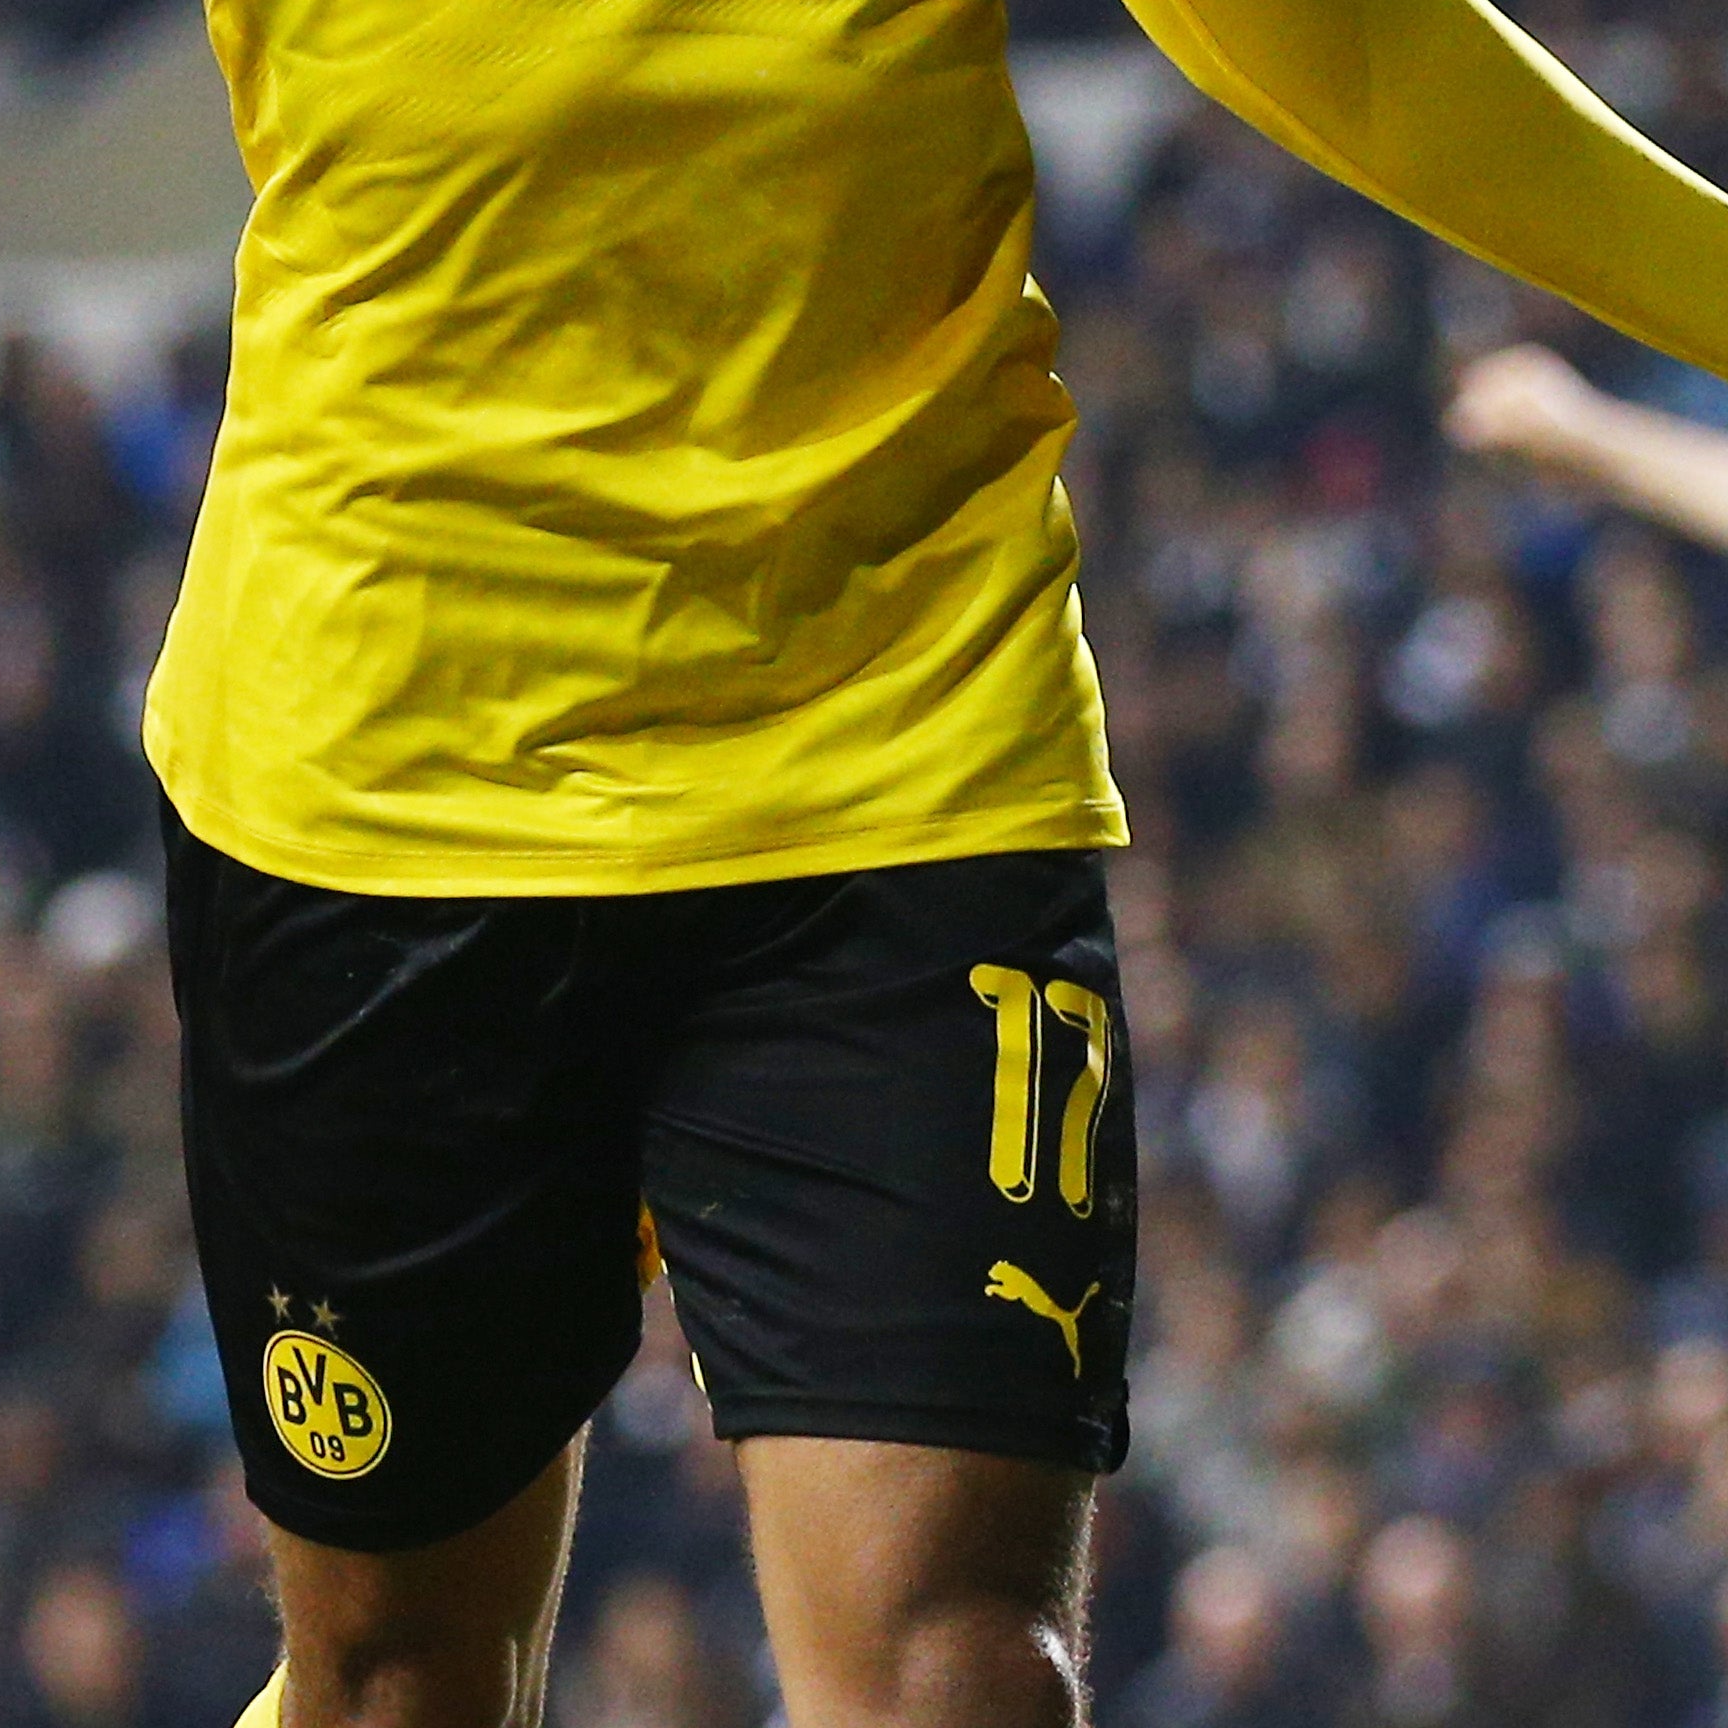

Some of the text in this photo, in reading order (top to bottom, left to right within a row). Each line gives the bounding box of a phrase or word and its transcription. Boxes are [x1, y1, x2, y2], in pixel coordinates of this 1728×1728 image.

[968, 962, 1112, 1220] 17
[276, 1345, 374, 1438] BVB
[309, 1431, 346, 1462] 09
